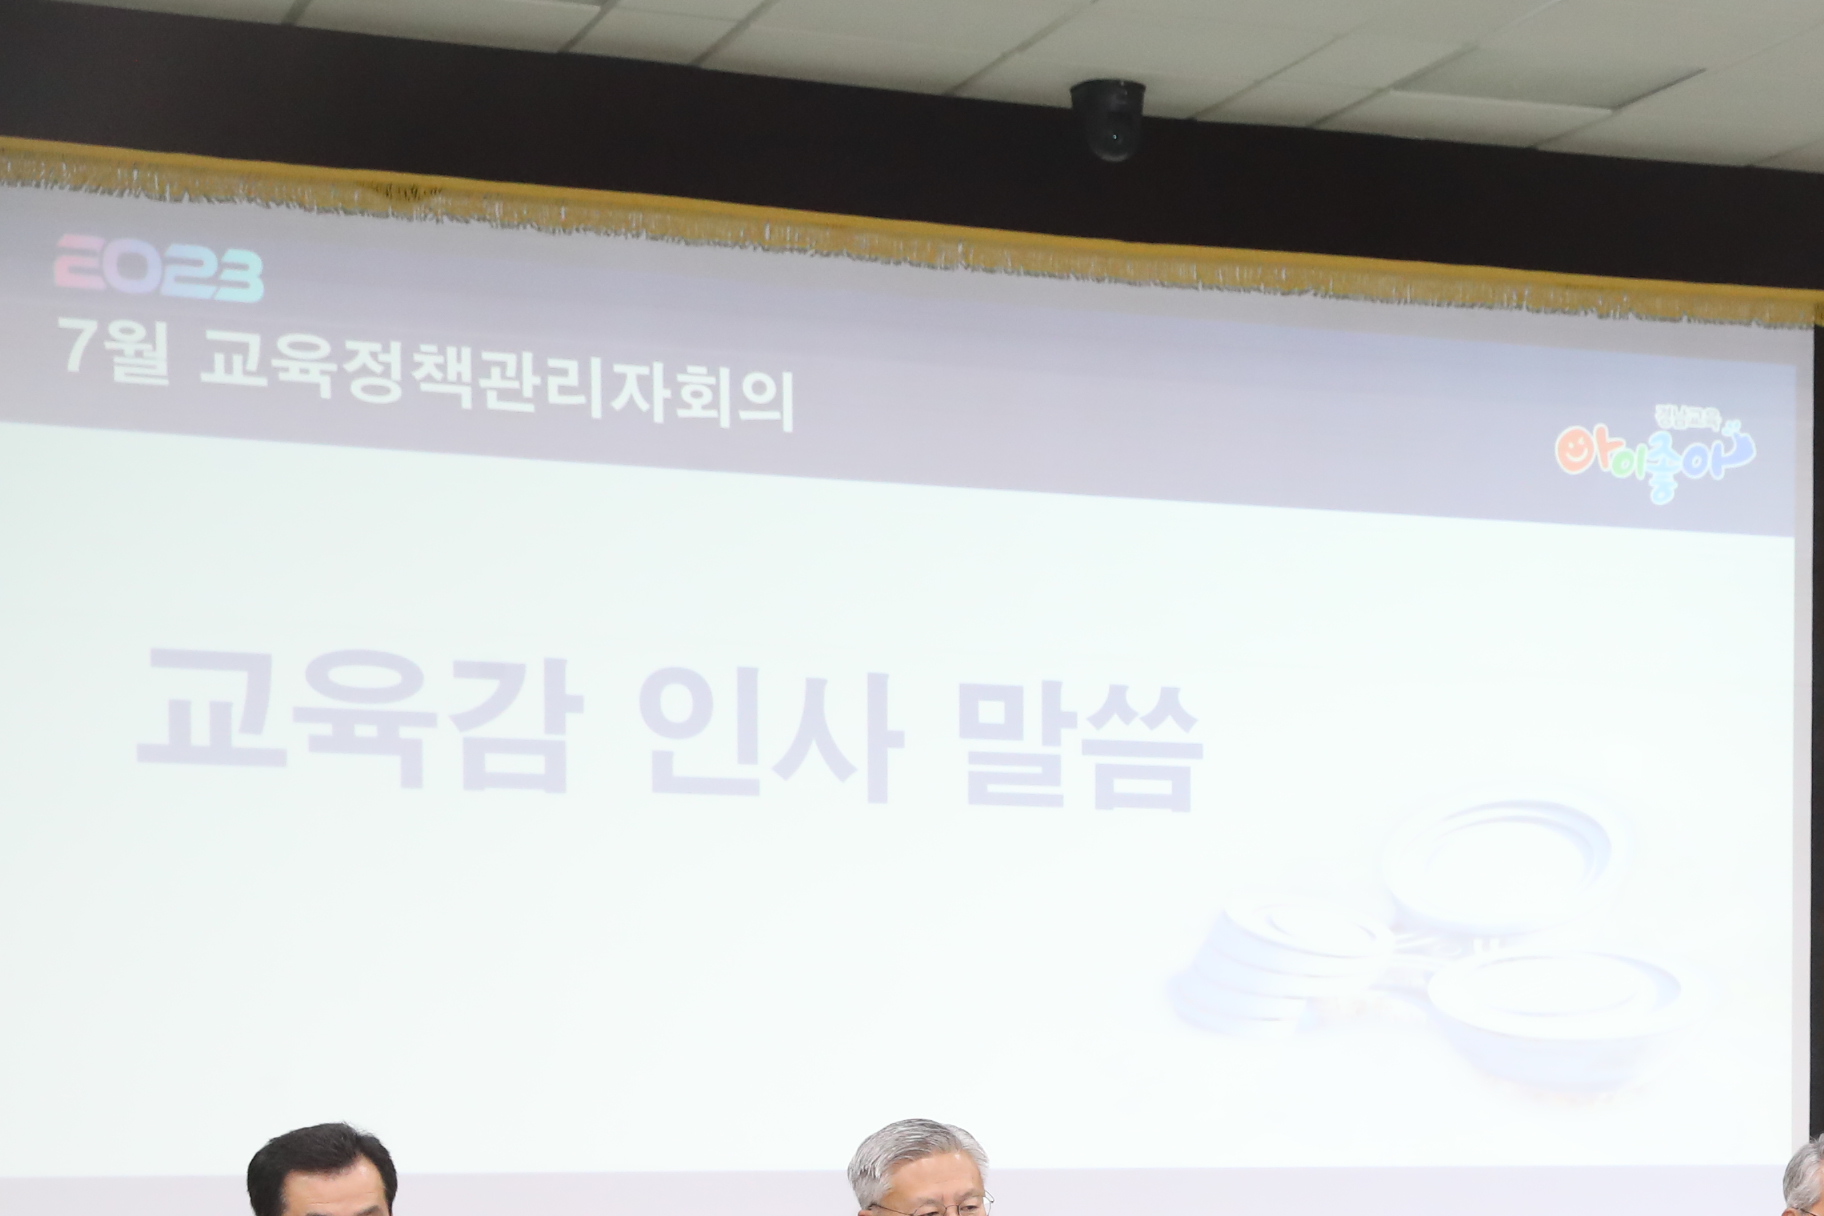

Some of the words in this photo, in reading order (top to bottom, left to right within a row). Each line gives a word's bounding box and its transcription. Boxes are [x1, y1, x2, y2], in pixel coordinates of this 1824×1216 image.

[54, 233, 264, 304] 2023
[57, 316, 170, 387] 7월
[200, 329, 794, 433] 교육정책관리자회의
[1555, 423, 1757, 505] 아이좋아
[136, 647, 584, 794] 교육감
[638, 665, 905, 804] 인사
[958, 679, 1204, 813] 말씀
